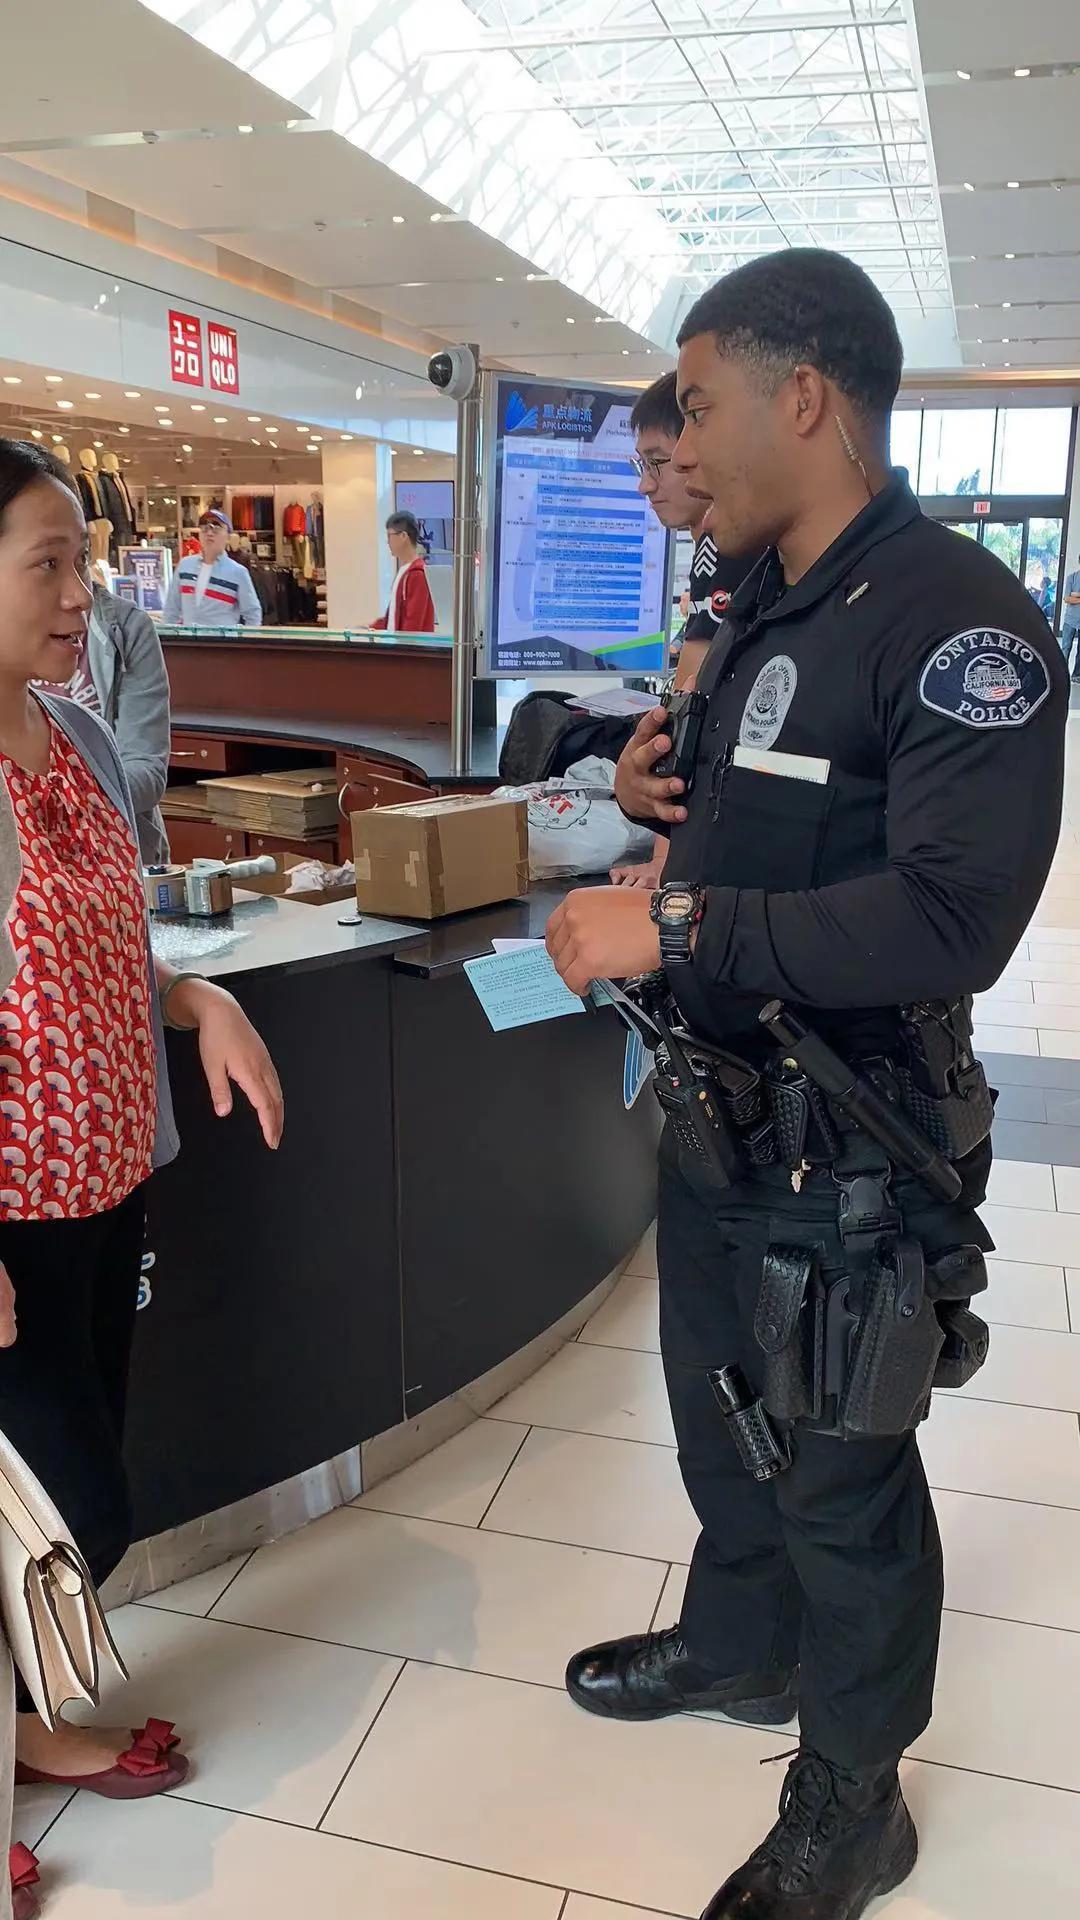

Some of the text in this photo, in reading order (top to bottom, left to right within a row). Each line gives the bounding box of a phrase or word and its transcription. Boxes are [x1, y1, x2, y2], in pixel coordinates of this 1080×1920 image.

[210, 331, 233, 359] UNI
[211, 359, 236, 387] QLO
[557, 422, 593, 433] LOGISTICS
[936, 633, 1034, 671] ONTARIO
[965, 679, 1006, 691] CALIFORNIA
[955, 696, 1030, 722] POLICE
